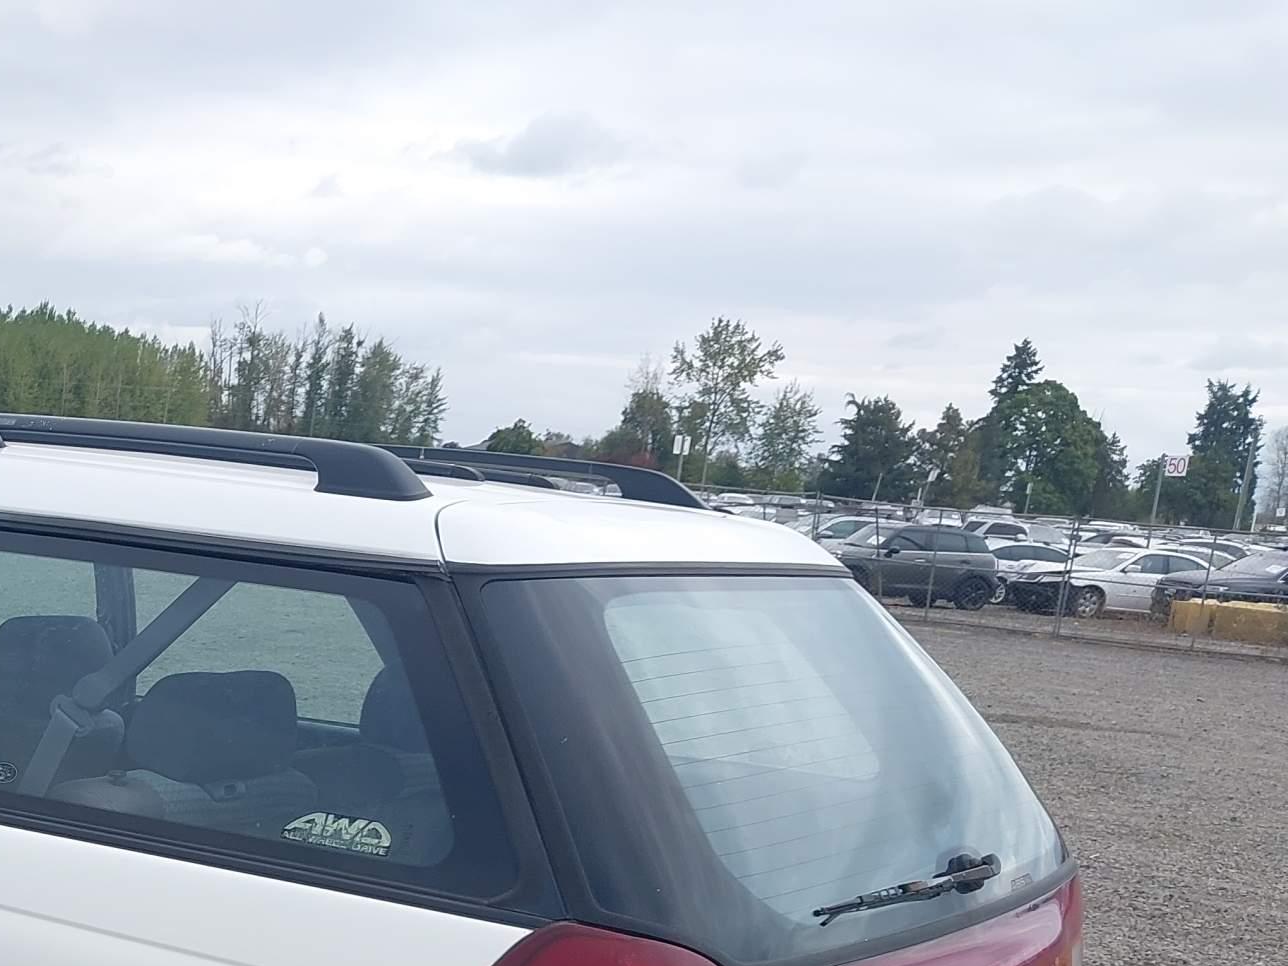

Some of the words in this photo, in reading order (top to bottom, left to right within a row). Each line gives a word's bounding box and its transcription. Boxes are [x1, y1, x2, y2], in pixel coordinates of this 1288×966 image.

[1167, 457, 1187, 475] 50
[283, 811, 392, 848] AWD
[282, 830, 303, 841] ALL
[308, 836, 348, 849] WHEEL
[352, 842, 388, 856] DRIVE
